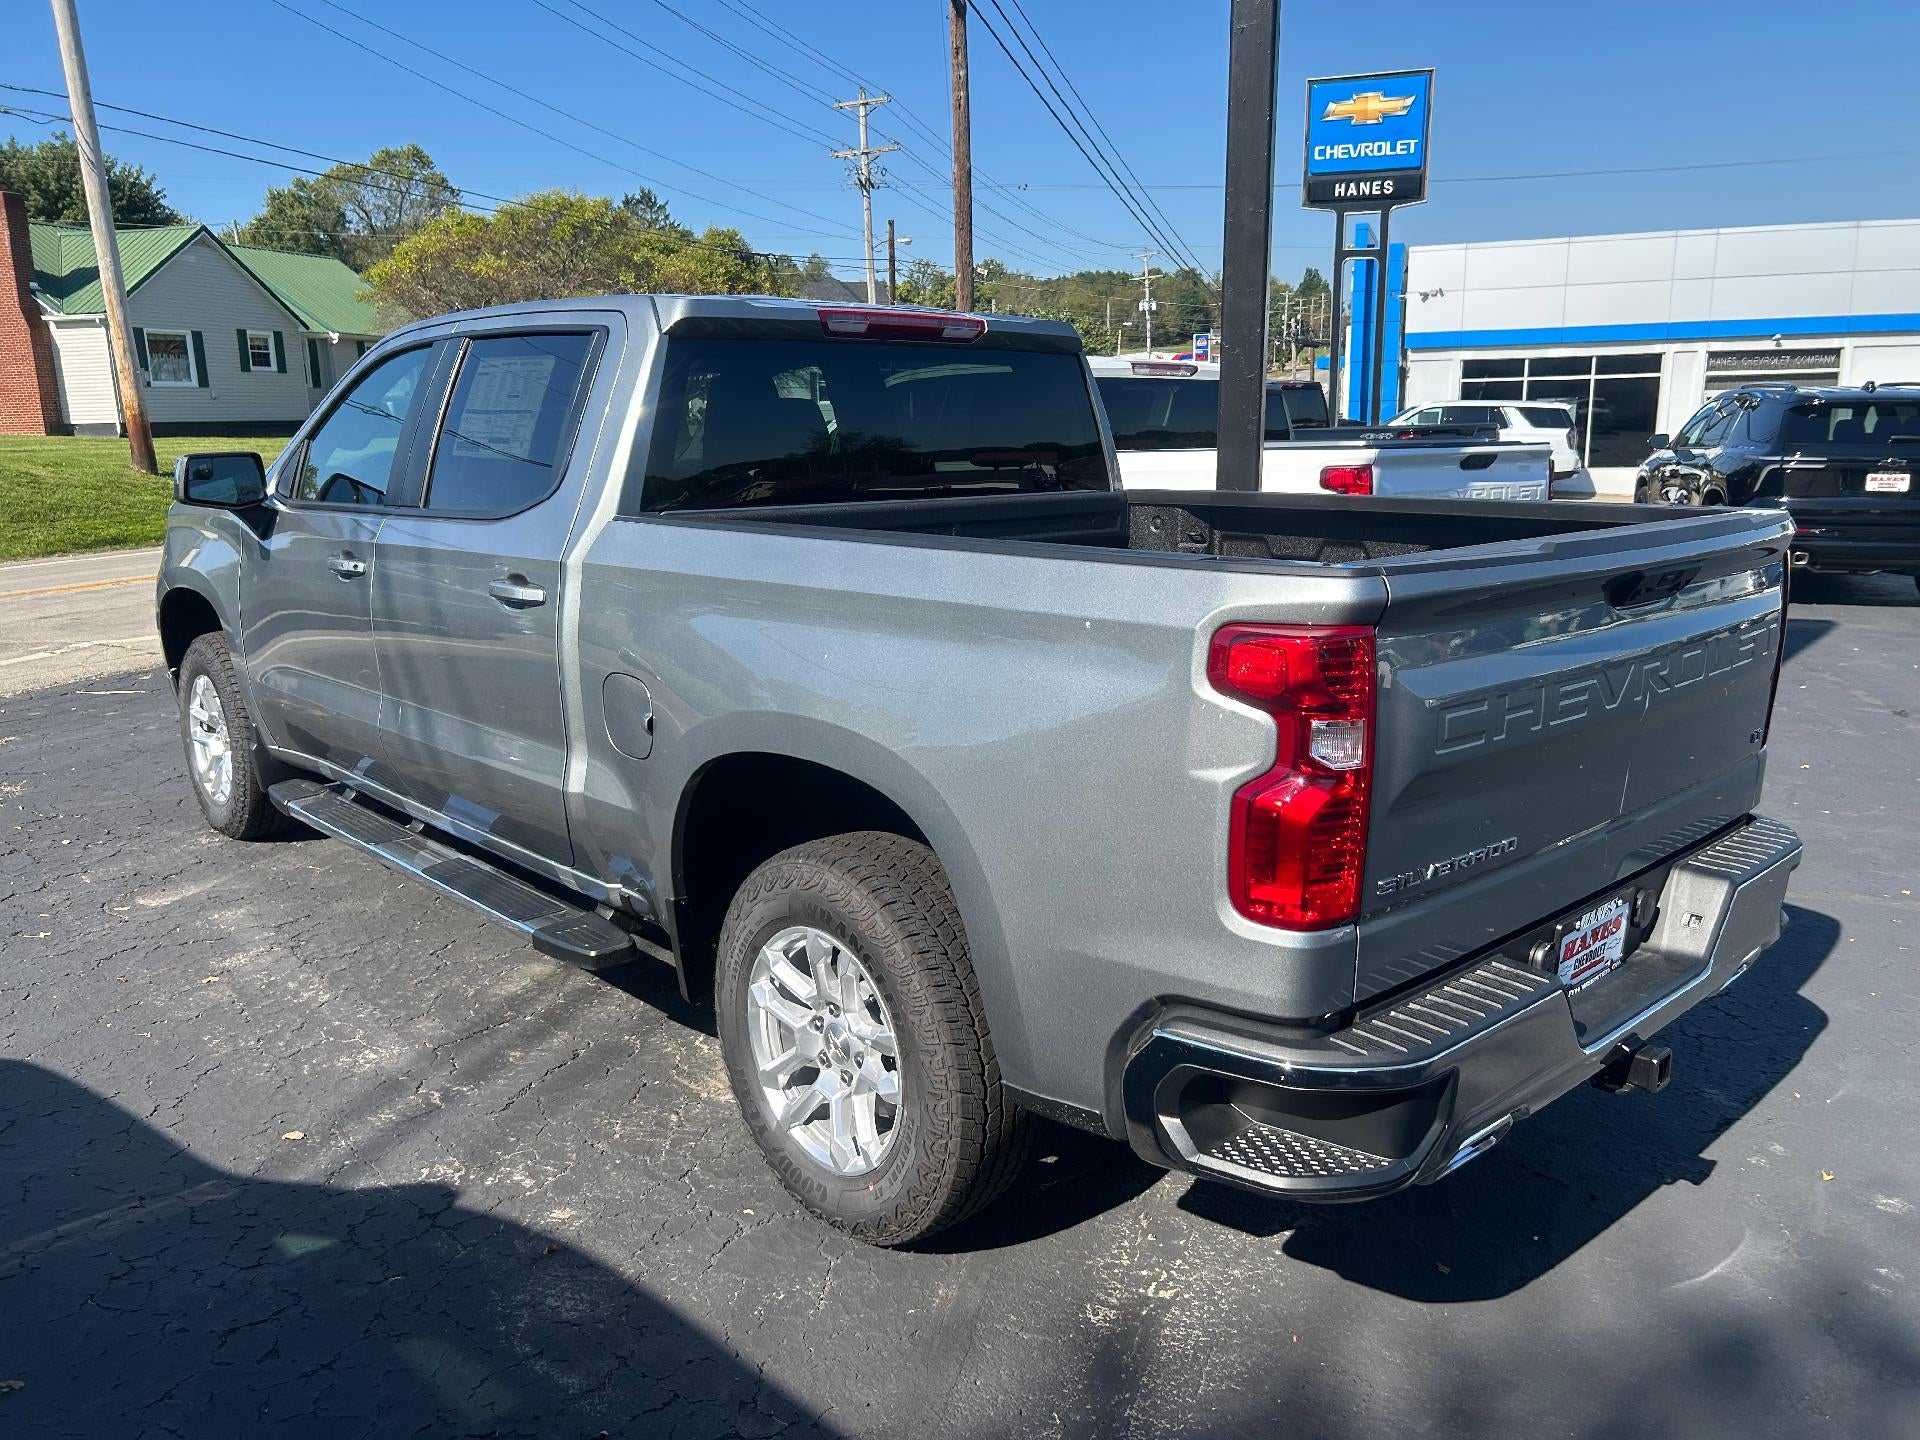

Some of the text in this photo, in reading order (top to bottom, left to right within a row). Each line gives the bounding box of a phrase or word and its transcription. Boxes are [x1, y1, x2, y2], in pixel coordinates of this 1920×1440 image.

[1314, 139, 1418, 160] CHEVROLET
[1334, 180, 1394, 197] HANES
[1709, 353, 1838, 366] HANES CHEVROLET COMPANY
[1434, 621, 1779, 755] CHEVROLET
[1376, 836, 1518, 895] SILVERADO
[1561, 911, 1624, 963] HANES
